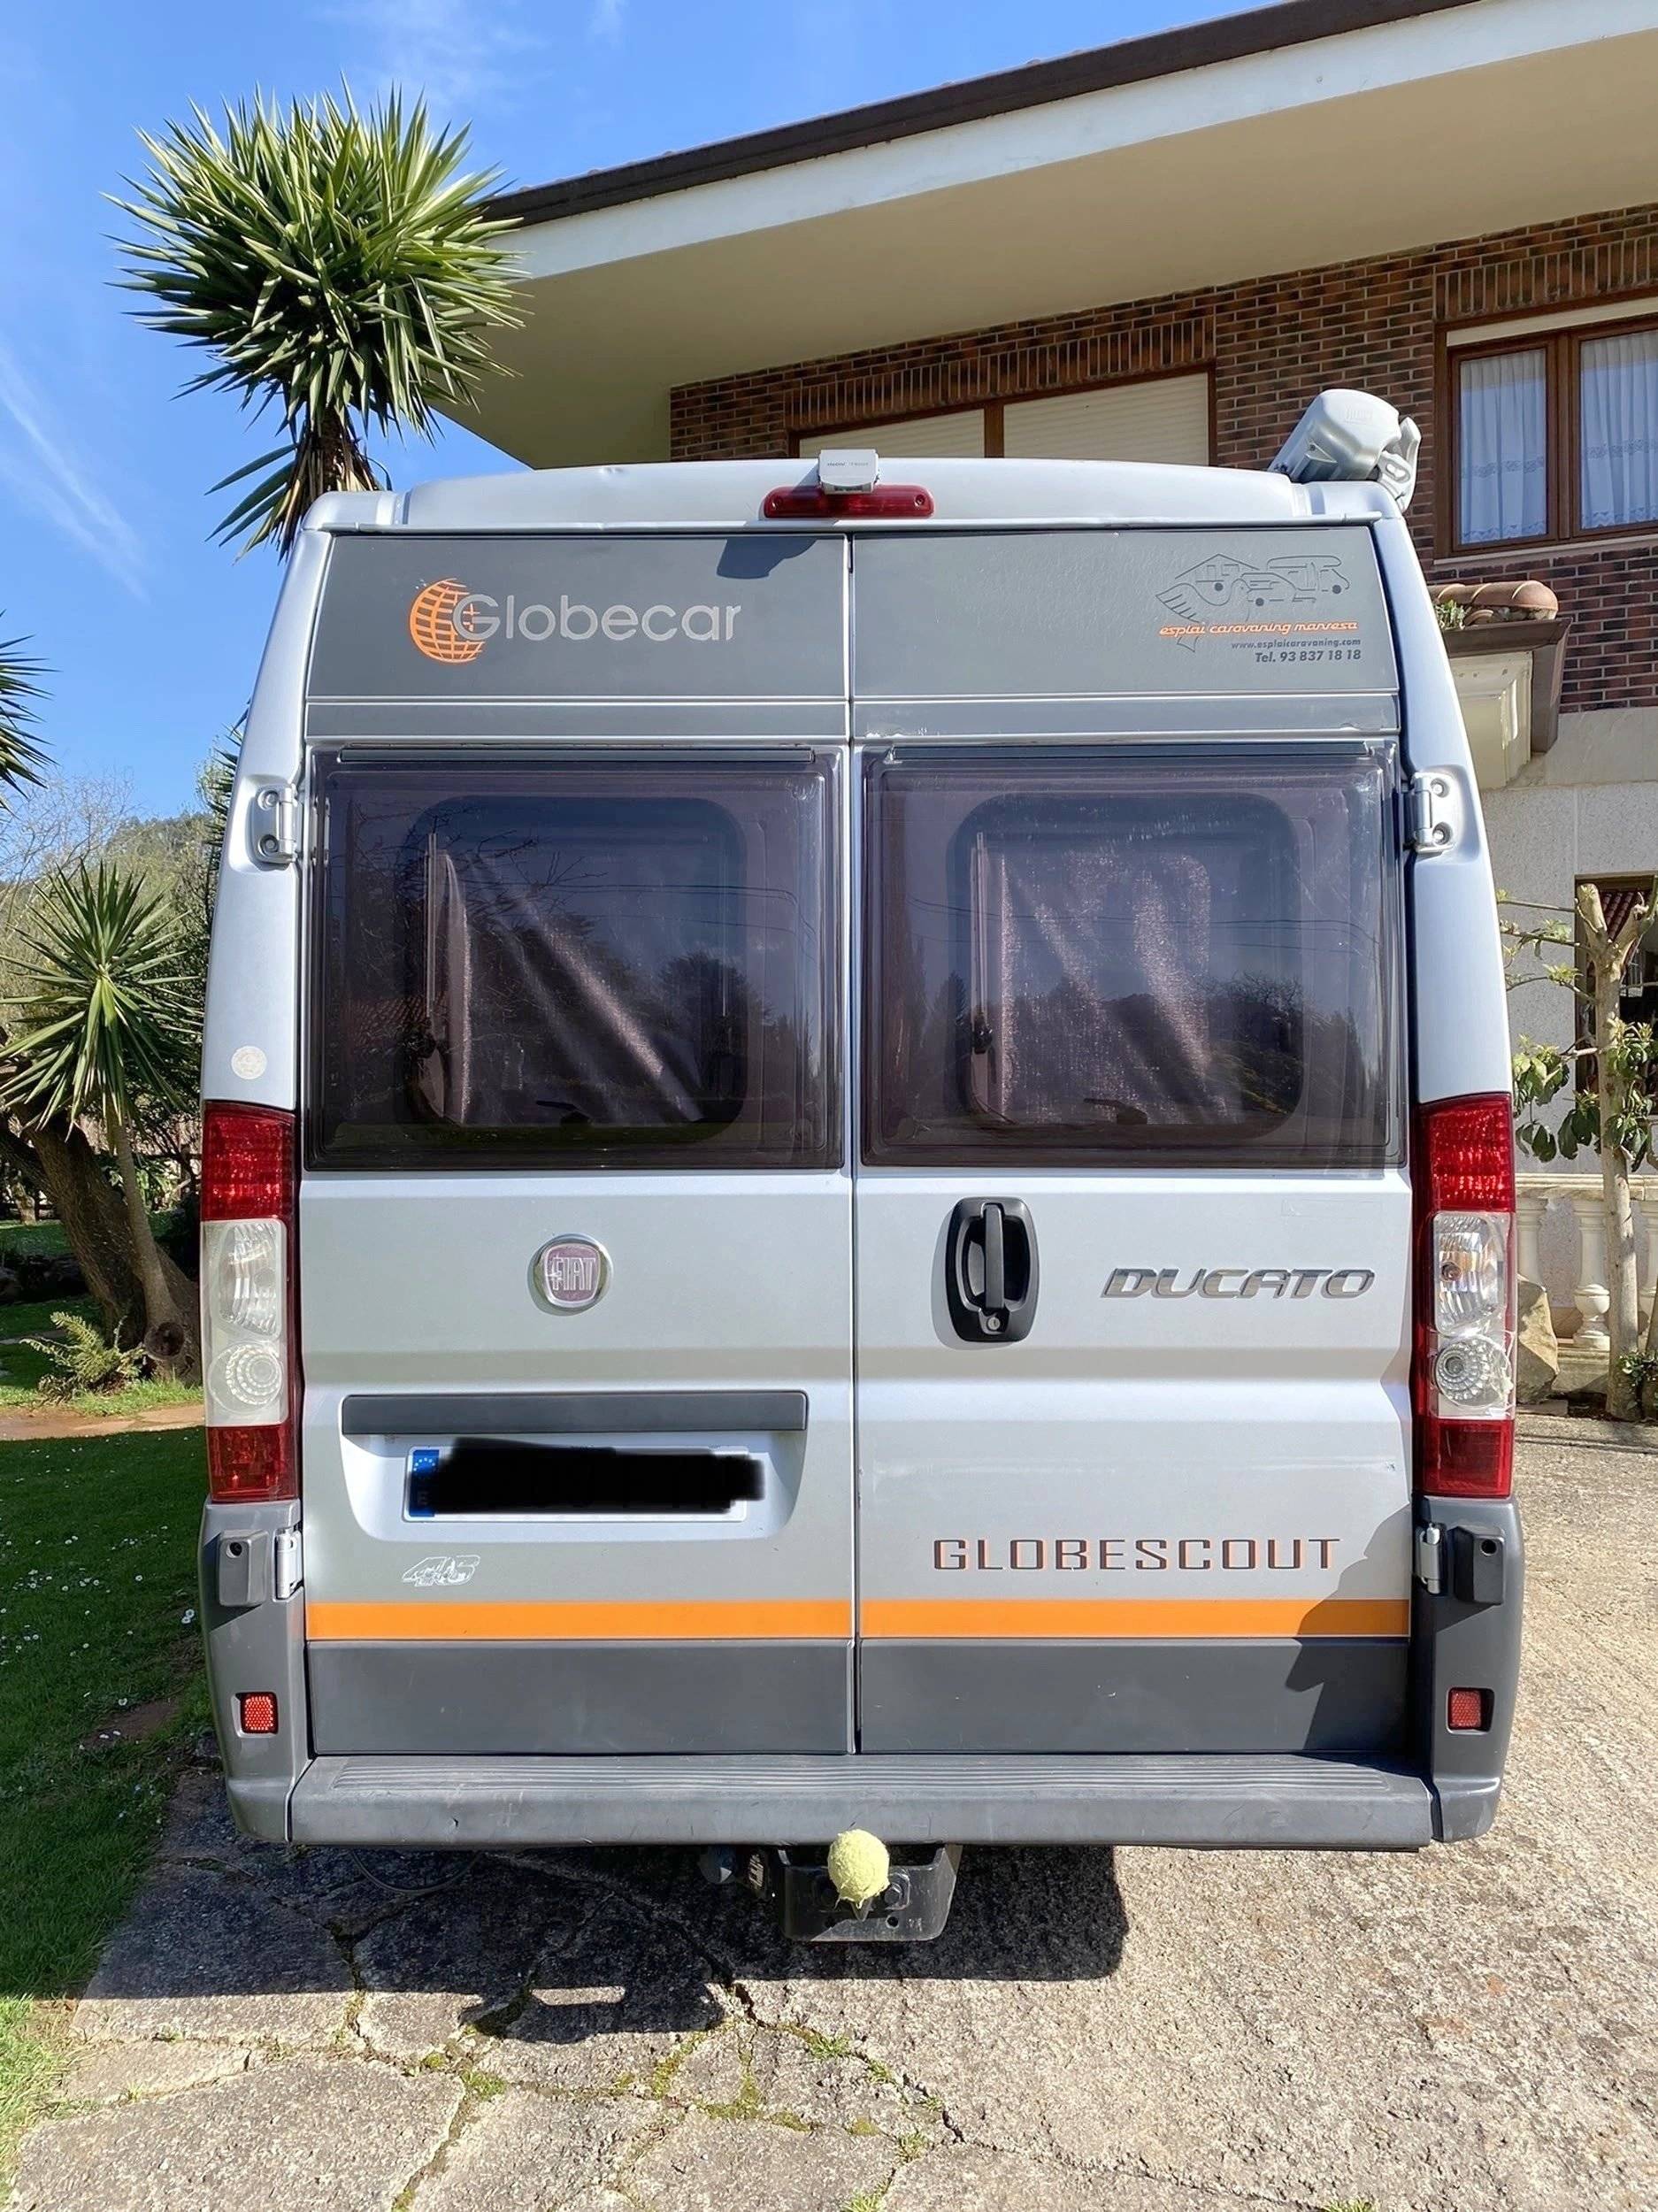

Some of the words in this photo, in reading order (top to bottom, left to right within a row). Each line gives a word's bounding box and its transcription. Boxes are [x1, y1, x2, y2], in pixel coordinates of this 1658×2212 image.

[452, 594, 741, 641] Globecar
[1159, 625, 1206, 637] esplai
[1231, 637, 1362, 649] www.esplaicaravaning.com
[1255, 651, 1277, 663] Tel.
[1279, 651, 1297, 663] 93
[1299, 650, 1324, 662] 837
[1328, 649, 1343, 661] 18
[1347, 649, 1362, 660] 18
[550, 1256, 596, 1291] FIAT
[1101, 1267, 1376, 1299] DUCATO
[933, 1538, 1341, 1571] GLOBESCOUT
